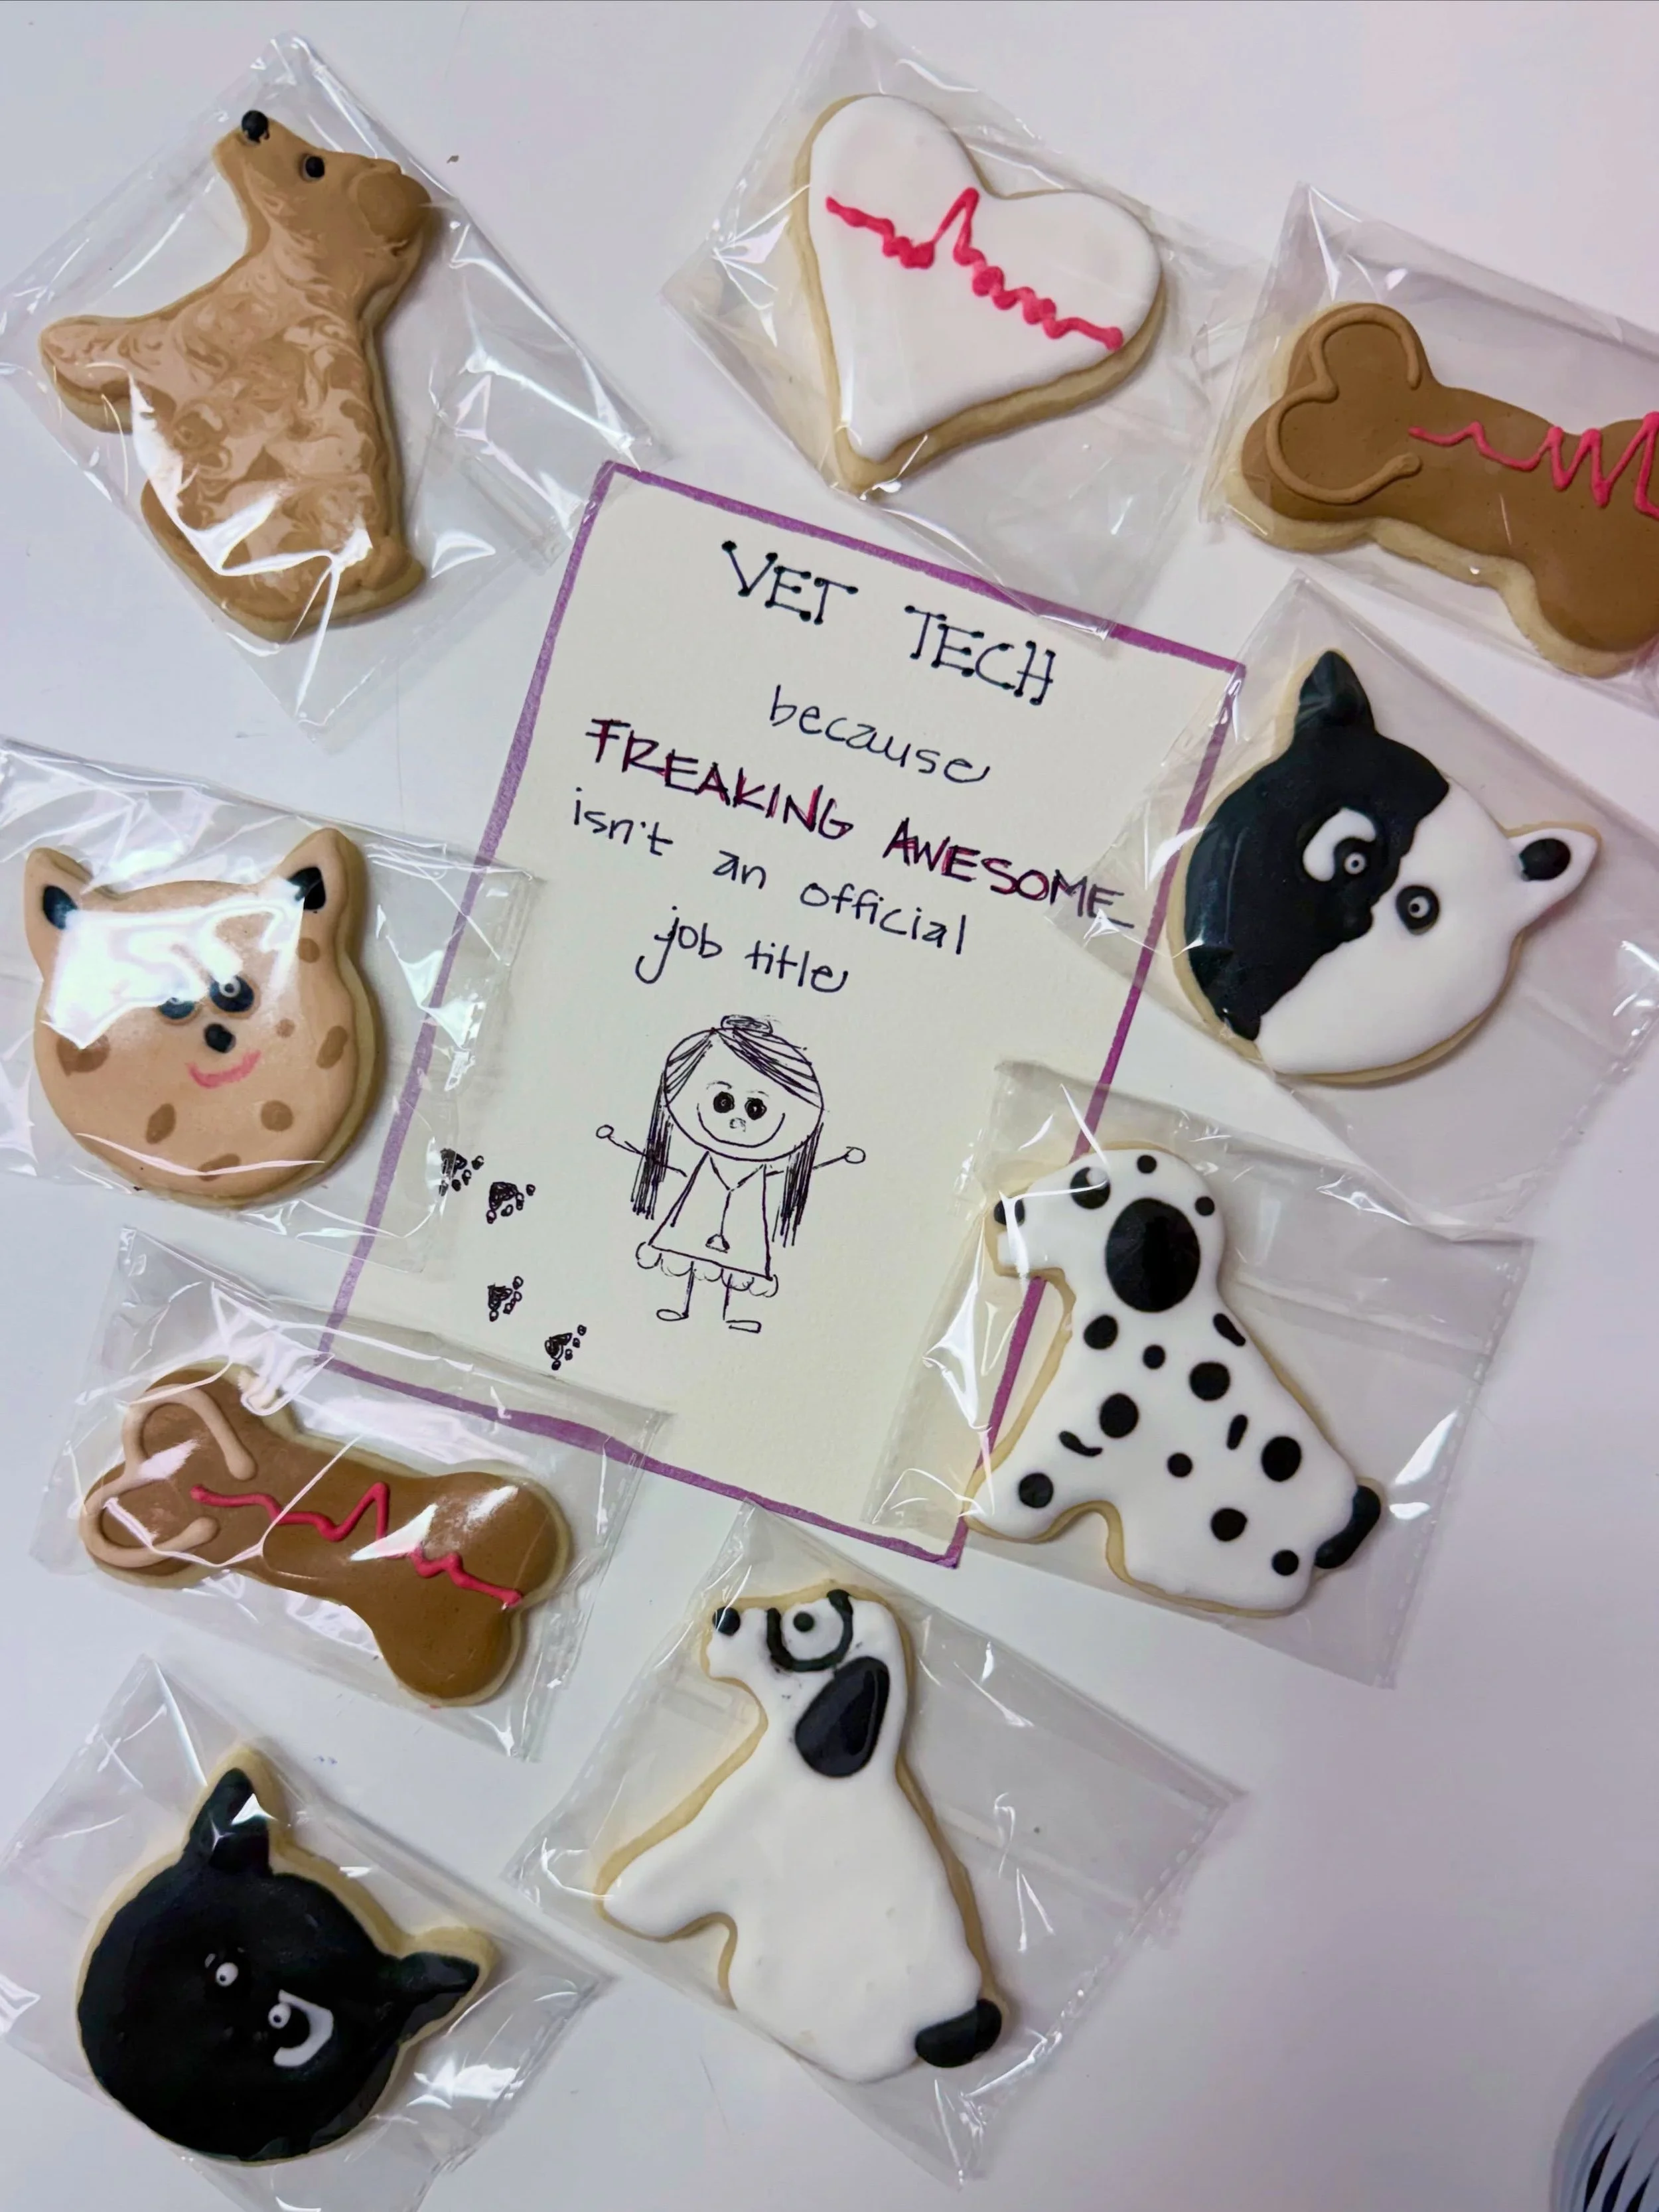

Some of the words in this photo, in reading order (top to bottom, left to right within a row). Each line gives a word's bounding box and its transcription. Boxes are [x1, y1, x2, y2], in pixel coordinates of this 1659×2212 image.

[722, 540, 858, 625] VET
[905, 605, 1056, 705] TECH
[769, 685, 991, 783] because
[573, 787, 674, 856] isn't
[713, 849, 768, 889] an
[800, 881, 967, 954] official
[585, 718, 854, 840] FREAKING
[883, 817, 1135, 929] AWESOME
[634, 906, 723, 984] job
[745, 940, 848, 994] title
